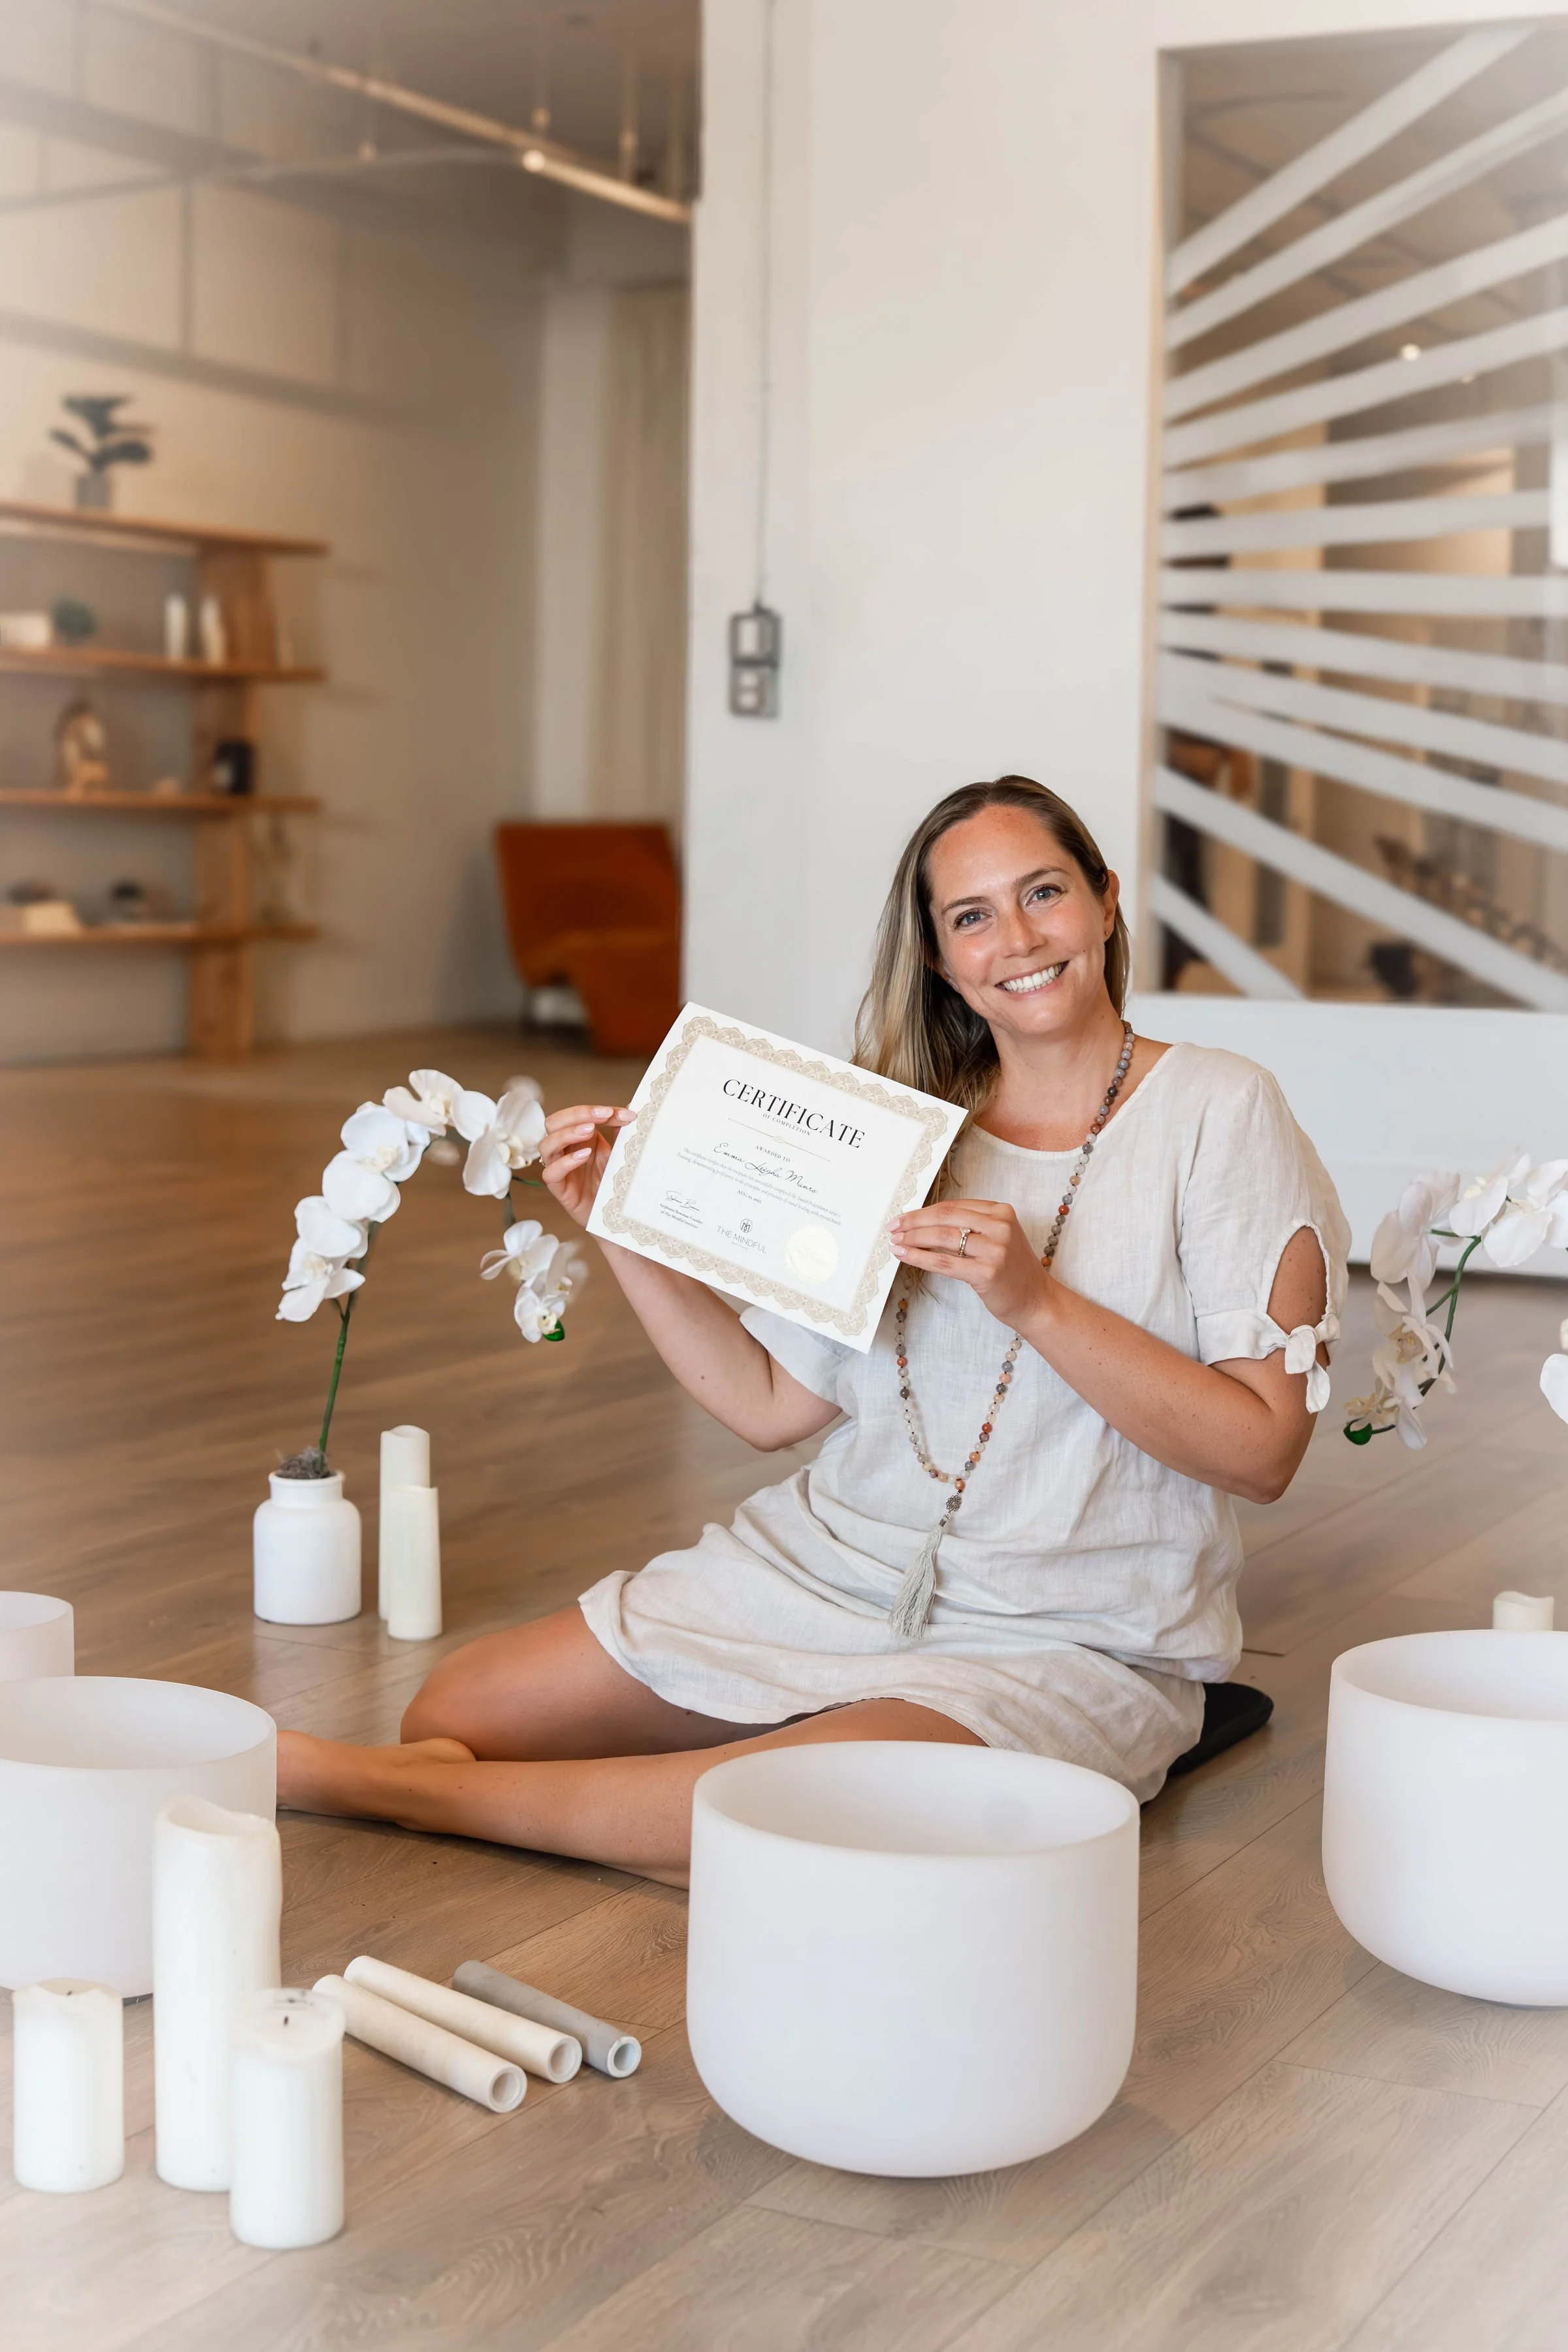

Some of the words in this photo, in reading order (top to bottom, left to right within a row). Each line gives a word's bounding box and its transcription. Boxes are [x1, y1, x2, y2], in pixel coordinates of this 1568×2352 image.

[723, 1079, 865, 1148] CERTIFICATE
[772, 1118, 811, 1135] COMPLETION
[713, 1143, 745, 1163] Emma
[755, 1145, 781, 1158] AWARDED
[717, 1226, 733, 1238] THE
[734, 1233, 766, 1253] MINDFUL
